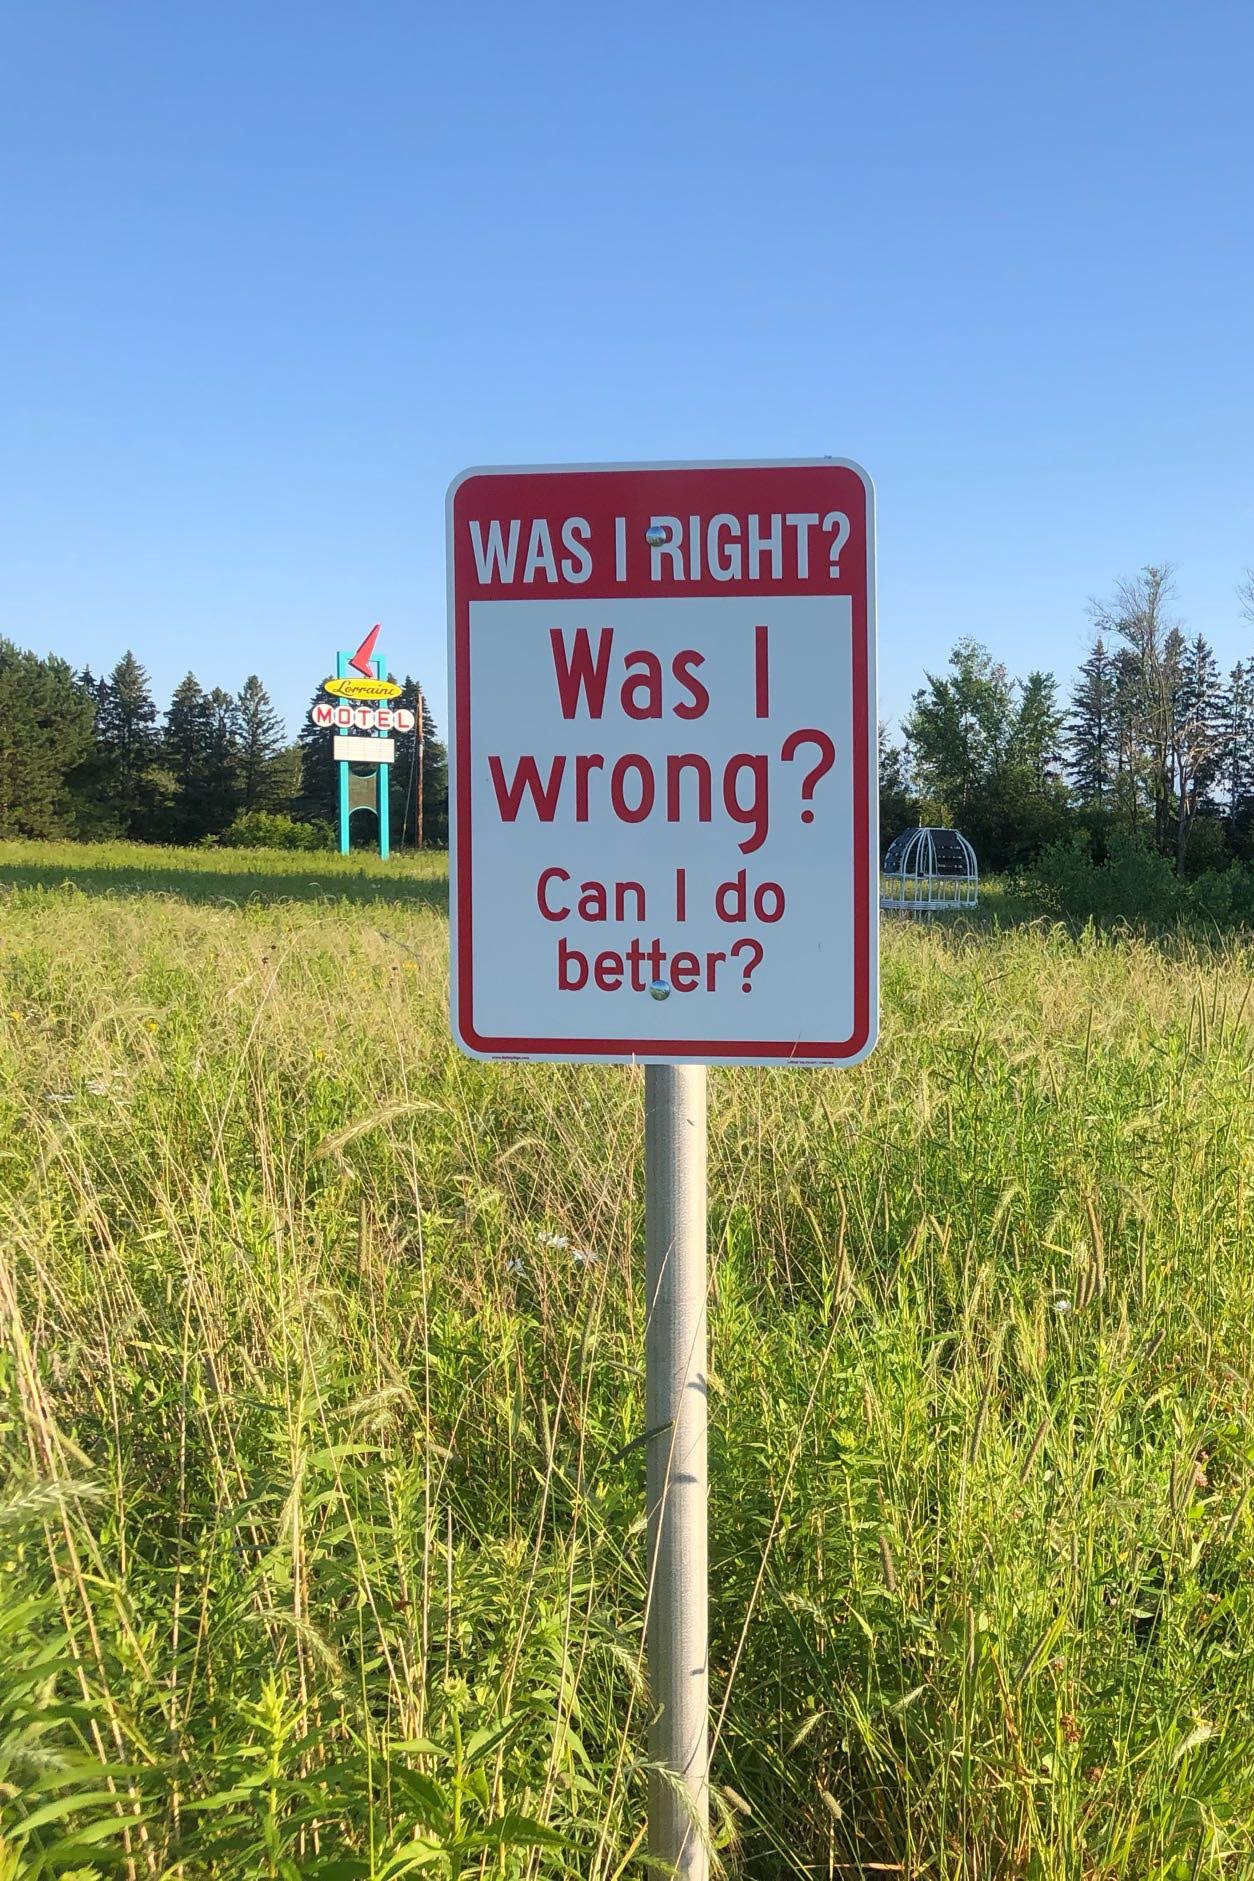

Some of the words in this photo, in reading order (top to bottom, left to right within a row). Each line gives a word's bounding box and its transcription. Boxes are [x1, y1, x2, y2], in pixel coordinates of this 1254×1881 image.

[468, 516, 593, 584] WAS
[614, 517, 627, 582] I
[649, 511, 851, 581] RIGHT?
[332, 680, 396, 696] Lorraine
[549, 627, 711, 720] Was
[755, 626, 770, 719] I
[317, 707, 410, 729] MOTEL
[488, 729, 836, 855] wrong?
[537, 867, 647, 922] Can
[676, 868, 687, 922] I
[715, 868, 786, 923] do
[558, 937, 765, 993] better?
